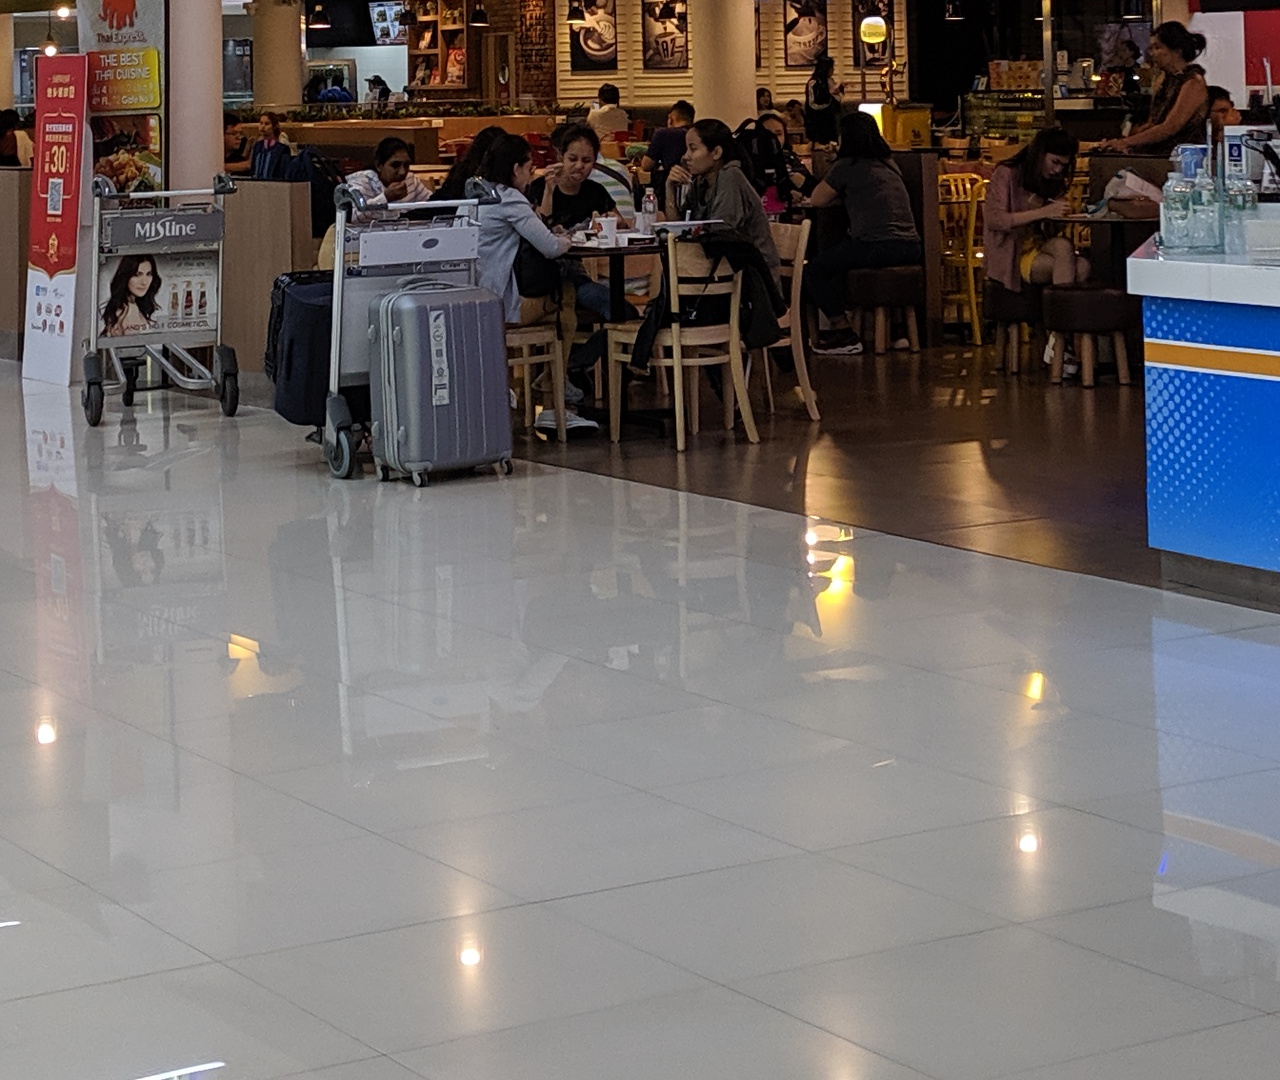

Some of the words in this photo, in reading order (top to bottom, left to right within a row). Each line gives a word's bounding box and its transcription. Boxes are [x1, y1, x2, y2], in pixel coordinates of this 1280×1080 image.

[100, 53, 118, 68] THE
[120, 51, 145, 66] BEST
[95, 69, 114, 81] THAI
[116, 67, 152, 80] CUISINE
[50, 145, 66, 174] 30
